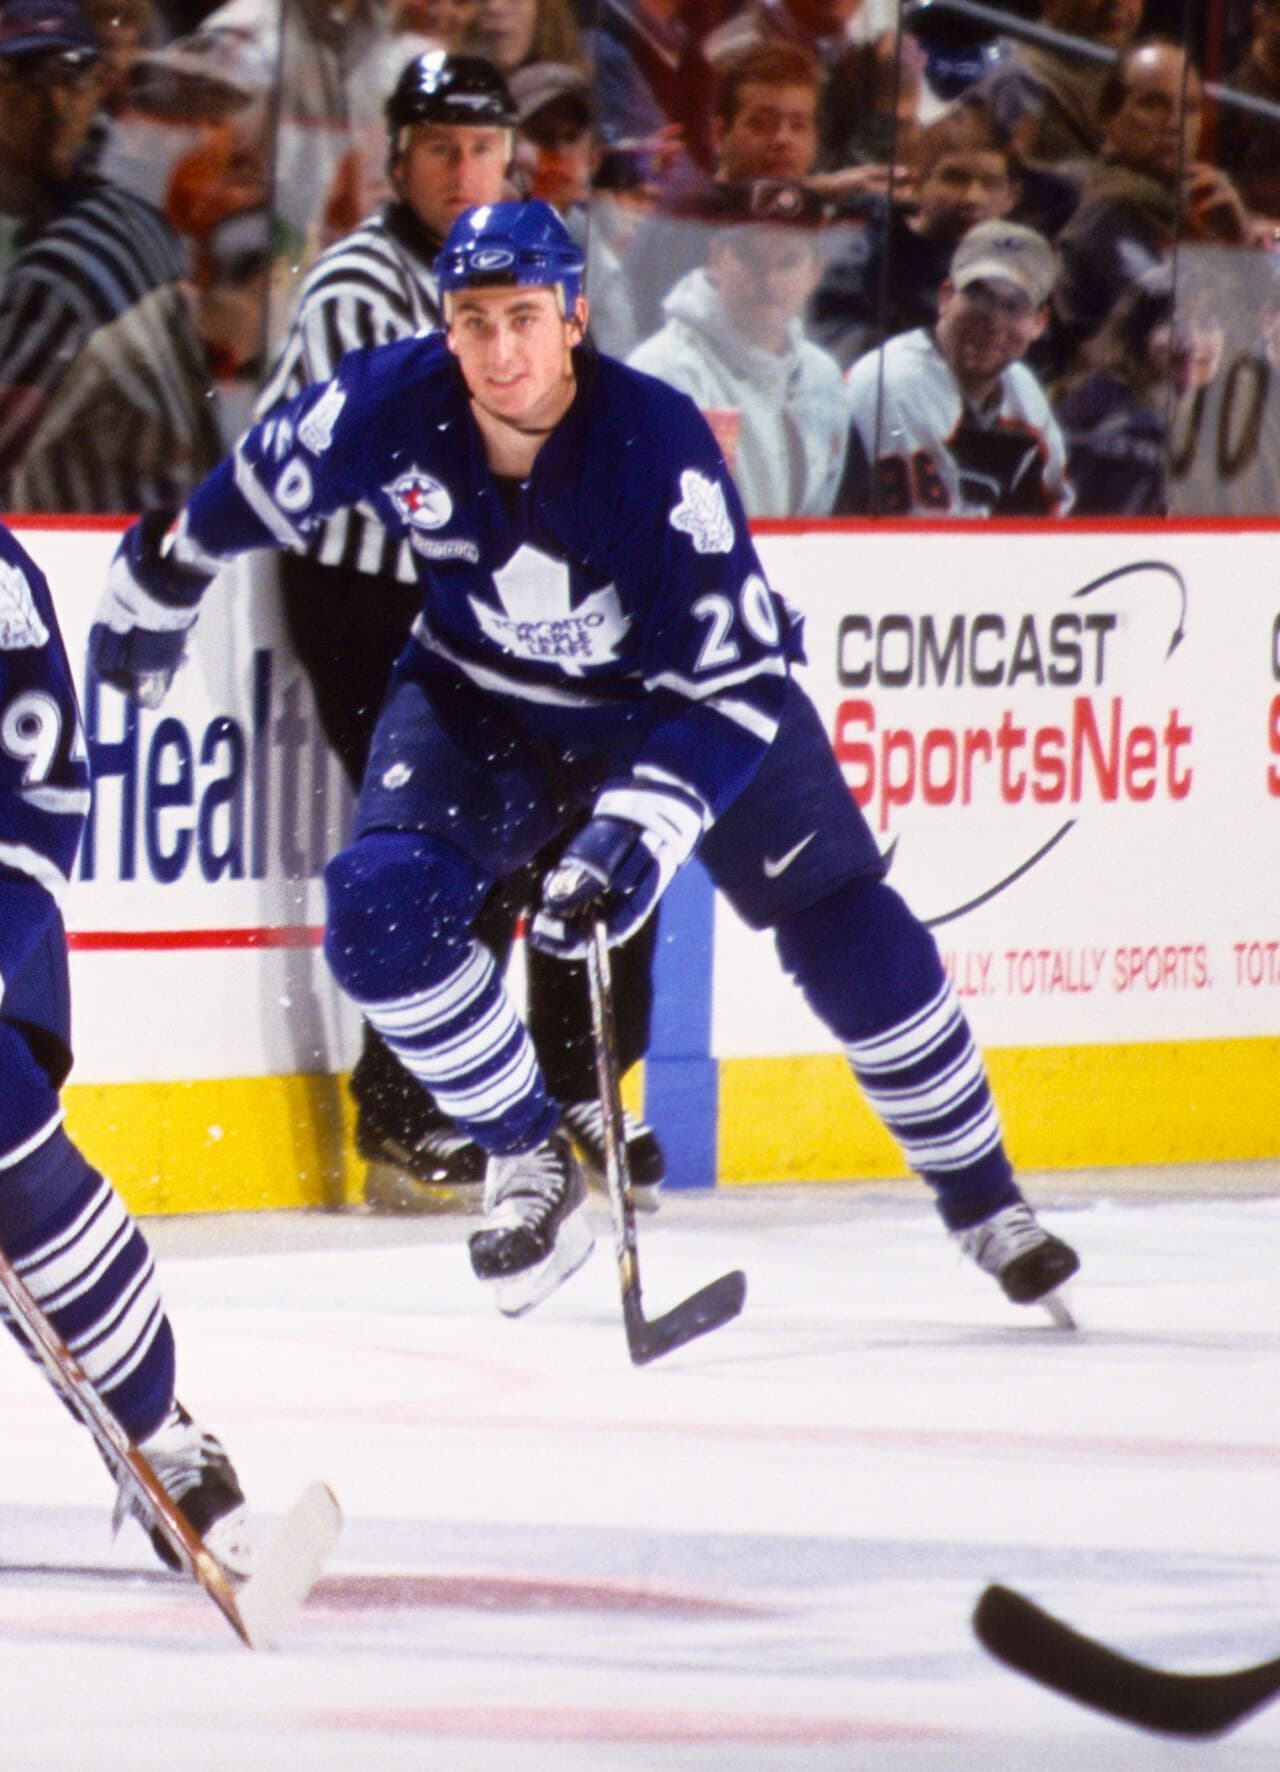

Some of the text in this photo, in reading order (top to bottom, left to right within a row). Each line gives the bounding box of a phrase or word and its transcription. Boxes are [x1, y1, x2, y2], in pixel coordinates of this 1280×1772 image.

[690, 573, 780, 673] 20
[837, 613, 1117, 688] COMCAST
[834, 697, 1194, 832] SportsNet
[1005, 948, 1107, 995] TOTALLY
[1114, 945, 1213, 992] SPORTS.
[1234, 942, 1280, 987] TOT
